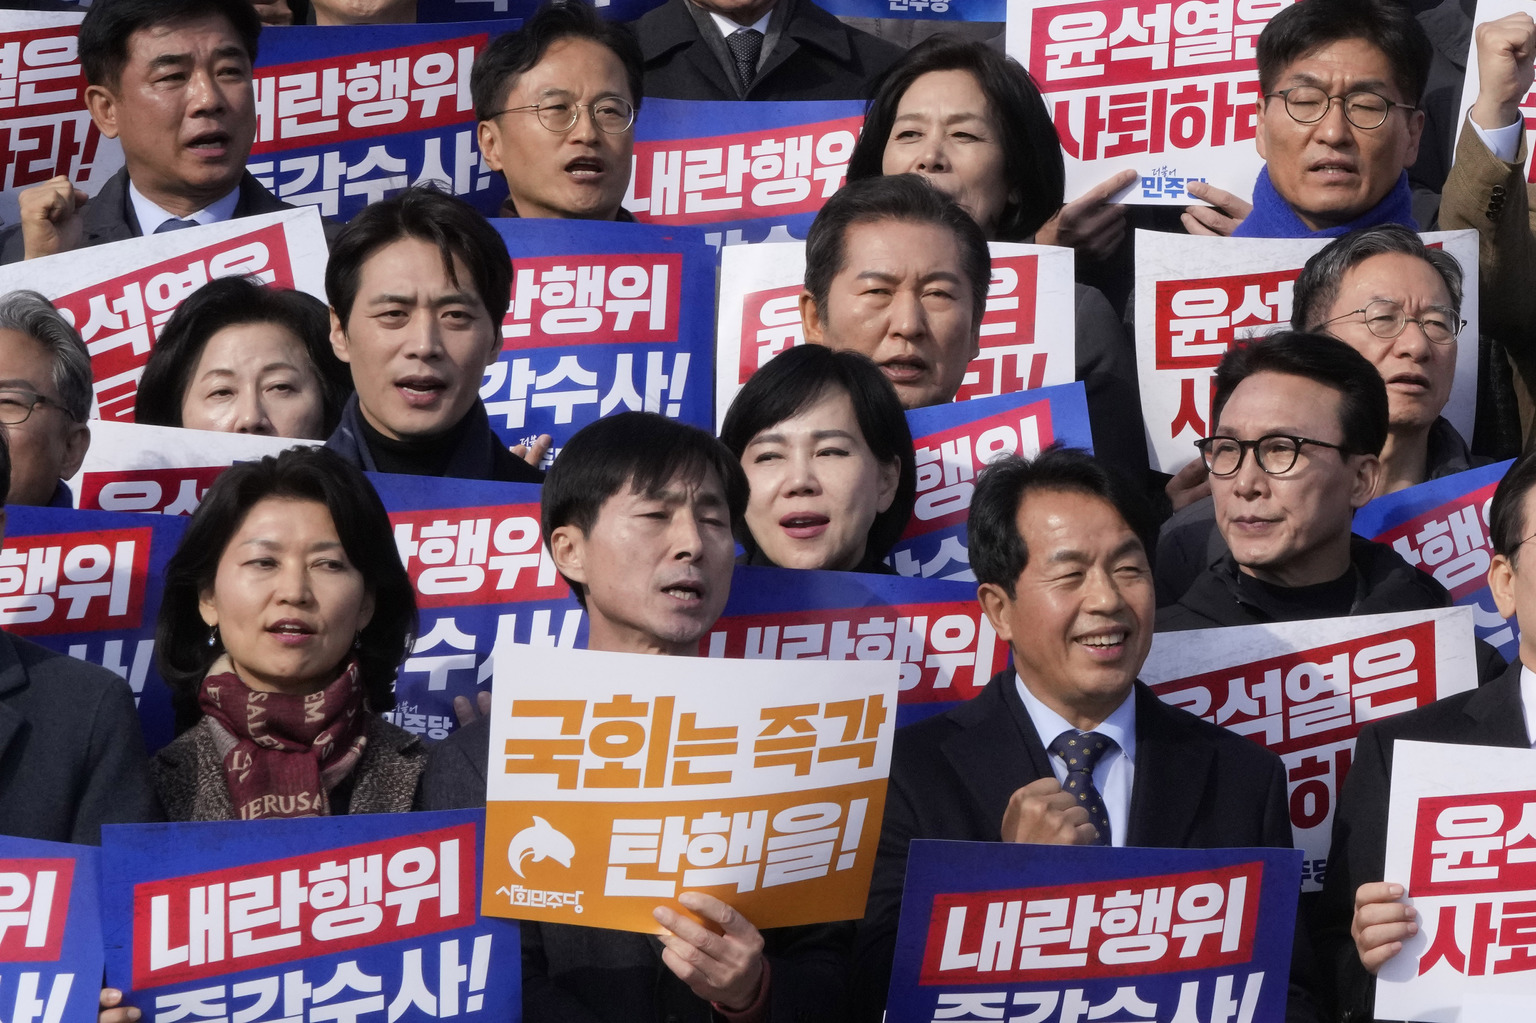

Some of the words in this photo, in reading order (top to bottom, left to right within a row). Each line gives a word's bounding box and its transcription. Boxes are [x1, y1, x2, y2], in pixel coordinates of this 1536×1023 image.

[1169, 279, 1297, 358] 윤석
[481, 351, 691, 430] 각수사!
[247, 692, 286, 752] SALE
[505, 694, 739, 790] 국회는
[754, 694, 886, 777] 즉각
[604, 798, 868, 898] 탄핵을!
[149, 838, 460, 973] 내란행위
[495, 884, 585, 915] 사회민주당
[939, 876, 1249, 973] 내란행위
